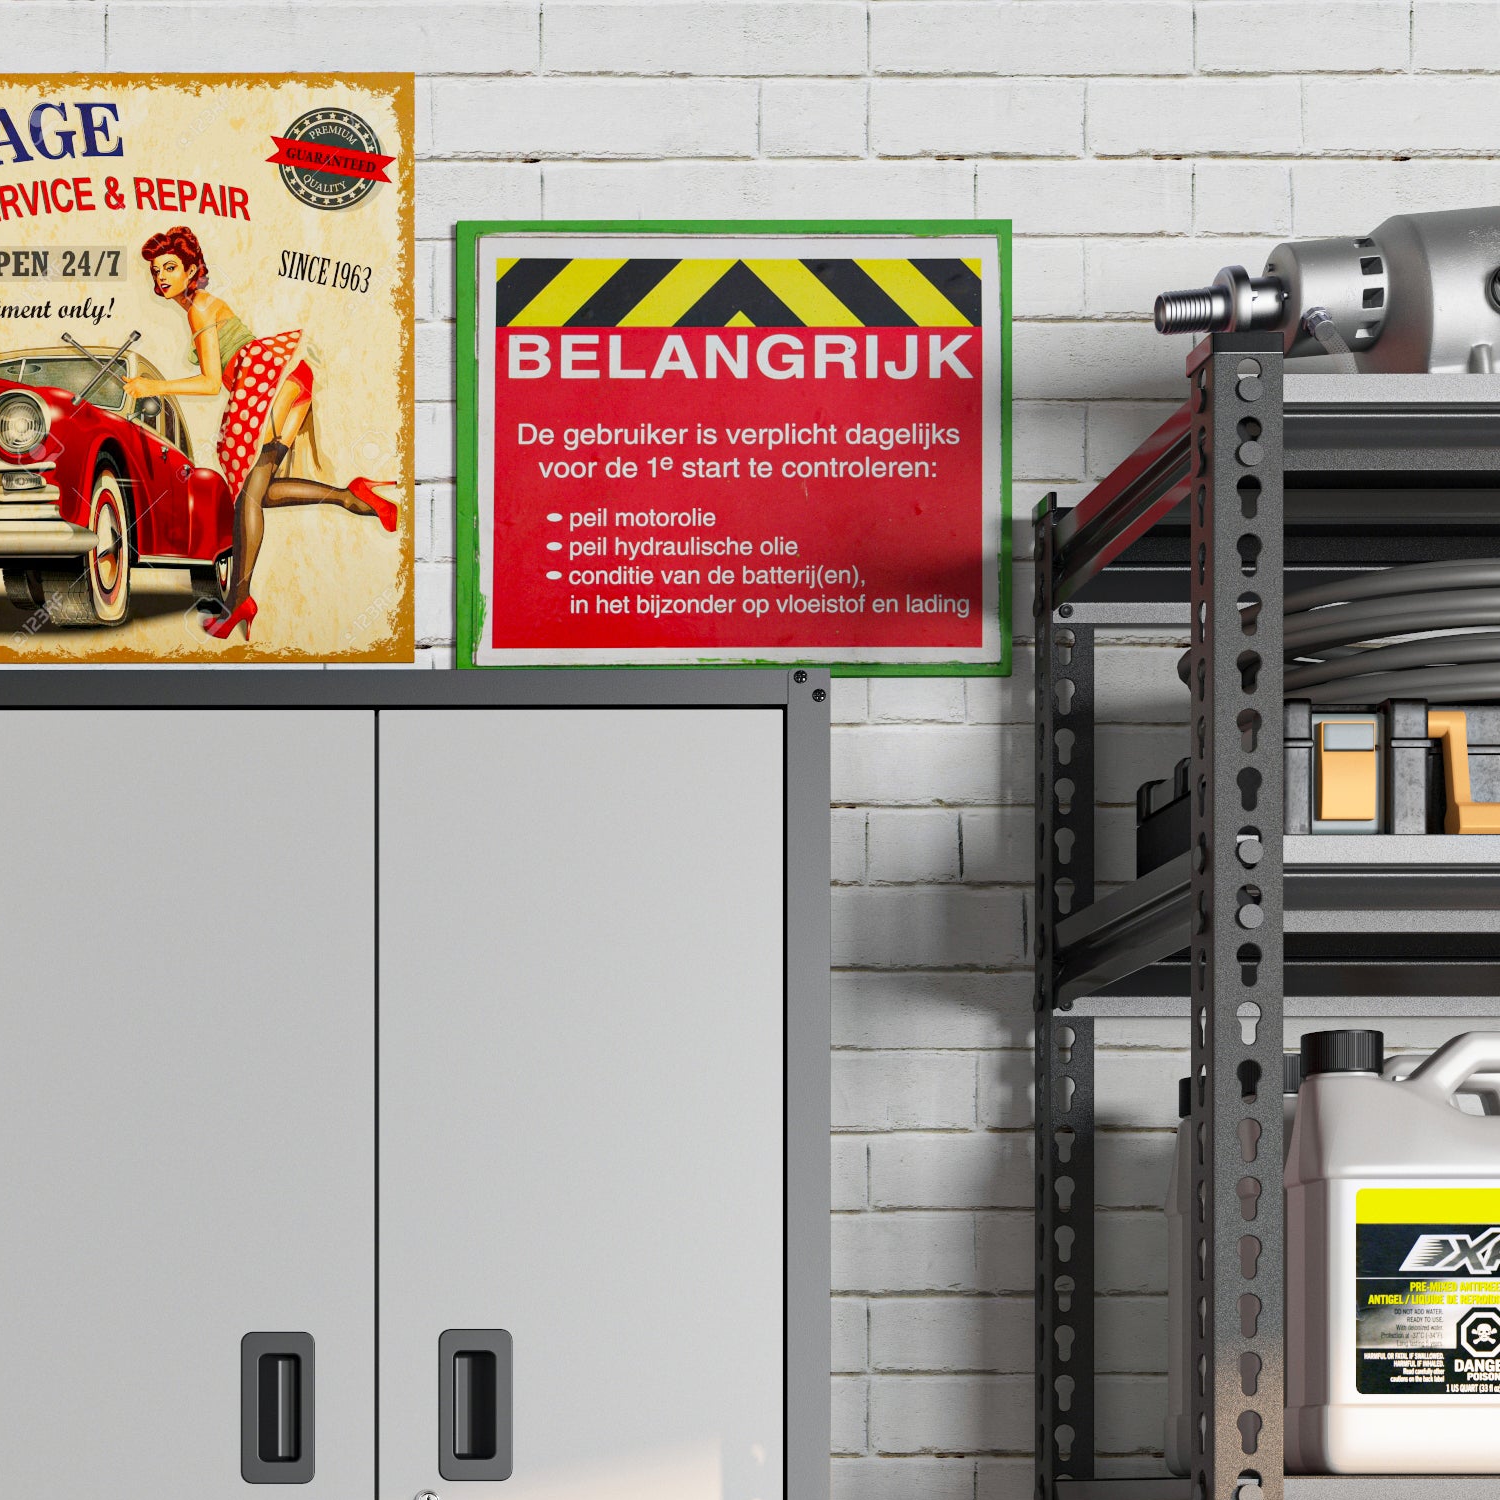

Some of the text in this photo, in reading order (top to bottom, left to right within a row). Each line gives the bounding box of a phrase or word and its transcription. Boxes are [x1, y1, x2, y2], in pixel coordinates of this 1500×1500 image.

[308, 125, 358, 145] PREMIUM
[286, 147, 376, 173] GUARANTEED
[303, 174, 347, 192] QUALITY
[105, 176, 126, 209] &
[135, 177, 251, 221] REPAIR
[62, 250, 121, 277] 24/7
[278, 250, 372, 293] SINCE 1963
[57, 296, 115, 326] only!
[508, 333, 974, 380] BELANGRIJK
[516, 422, 960, 451] De gebruiker is verplicht dagelijks
[538, 460, 598, 480] voor
[605, 456, 638, 479] de
[682, 457, 741, 479] start
[748, 457, 773, 479] te
[781, 456, 938, 479] controleren:
[569, 507, 716, 531] peil motorolie
[569, 535, 799, 560] peil hydraulische olie
[568, 564, 866, 591] conditie van de batterij(en),
[570, 594, 971, 620] in het bijzonder op vloeistof en lading
[1367, 1294, 1404, 1305] ANTIGEL
[1409, 1282, 1458, 1293] PRE-MIXED
[1451, 1384, 1479, 1393] US QUART
